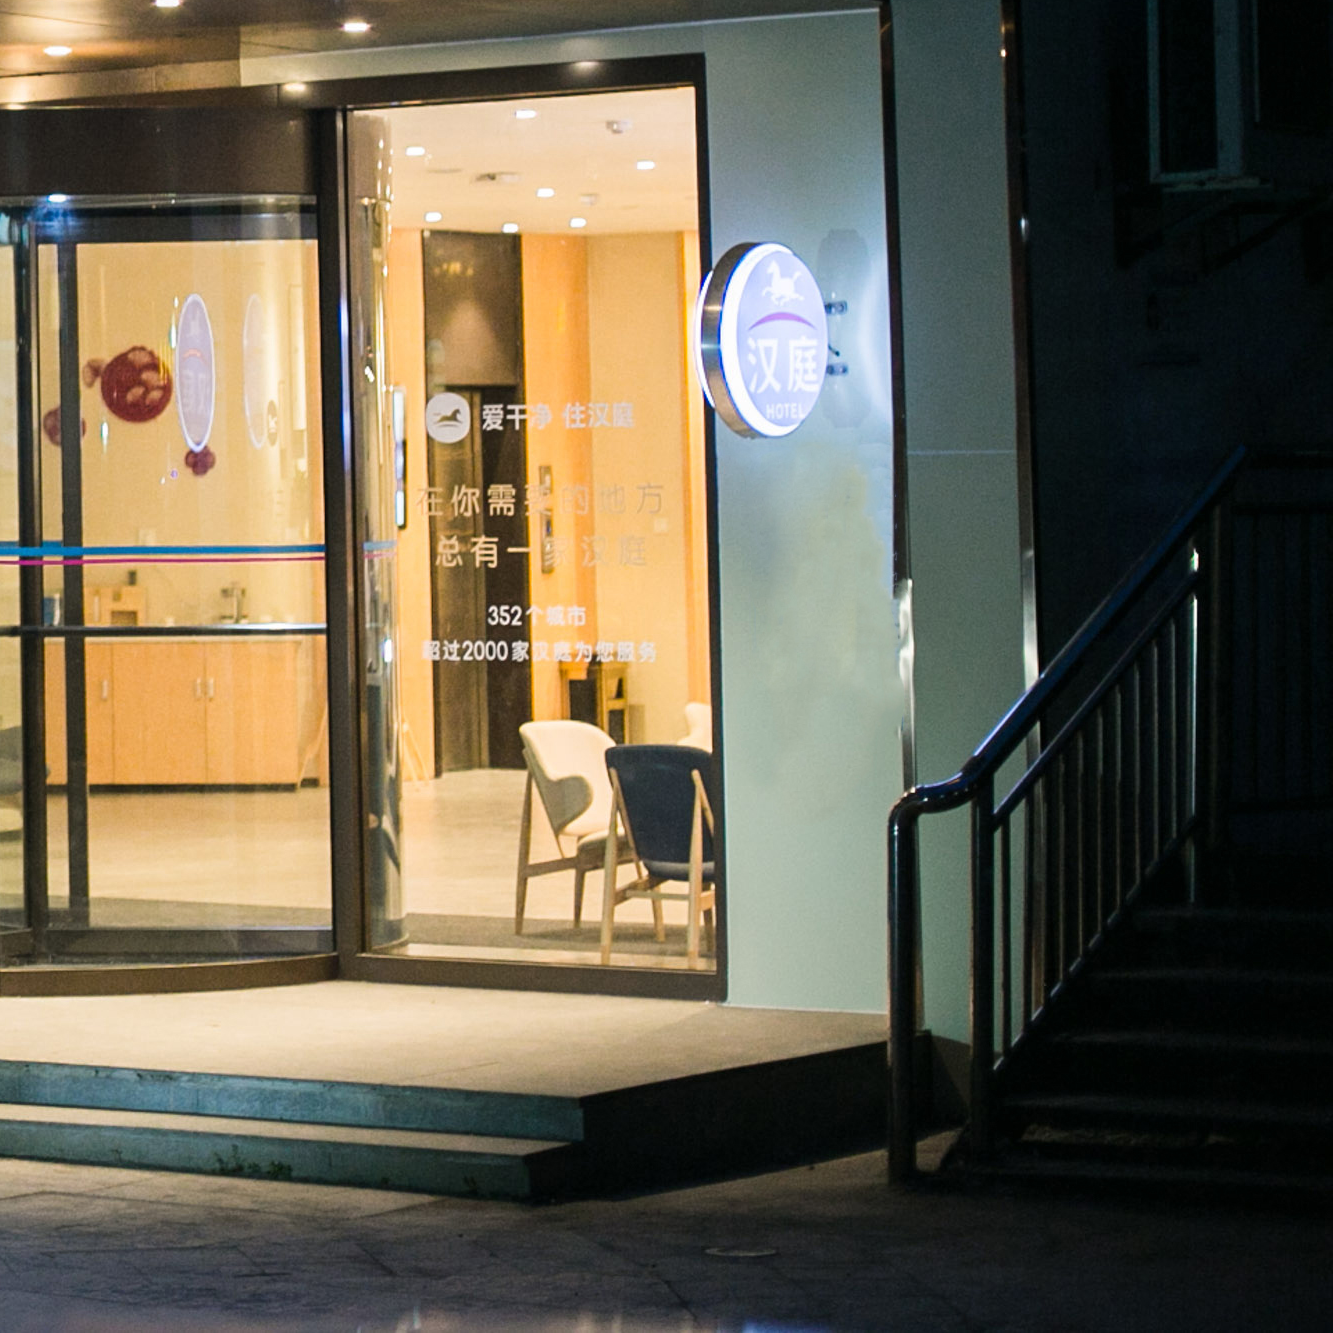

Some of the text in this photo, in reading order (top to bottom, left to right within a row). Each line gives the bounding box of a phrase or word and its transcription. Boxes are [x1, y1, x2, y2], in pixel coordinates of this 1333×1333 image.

[746, 336, 821, 395] 汉庭
[482, 402, 635, 431] 爱干净 住汉庭
[765, 403, 806, 420] HOTEL
[416, 482, 664, 518] 在你需要的地方
[435, 534, 647, 569] 总有一家汉庭
[487, 605, 586, 627] 352个城市
